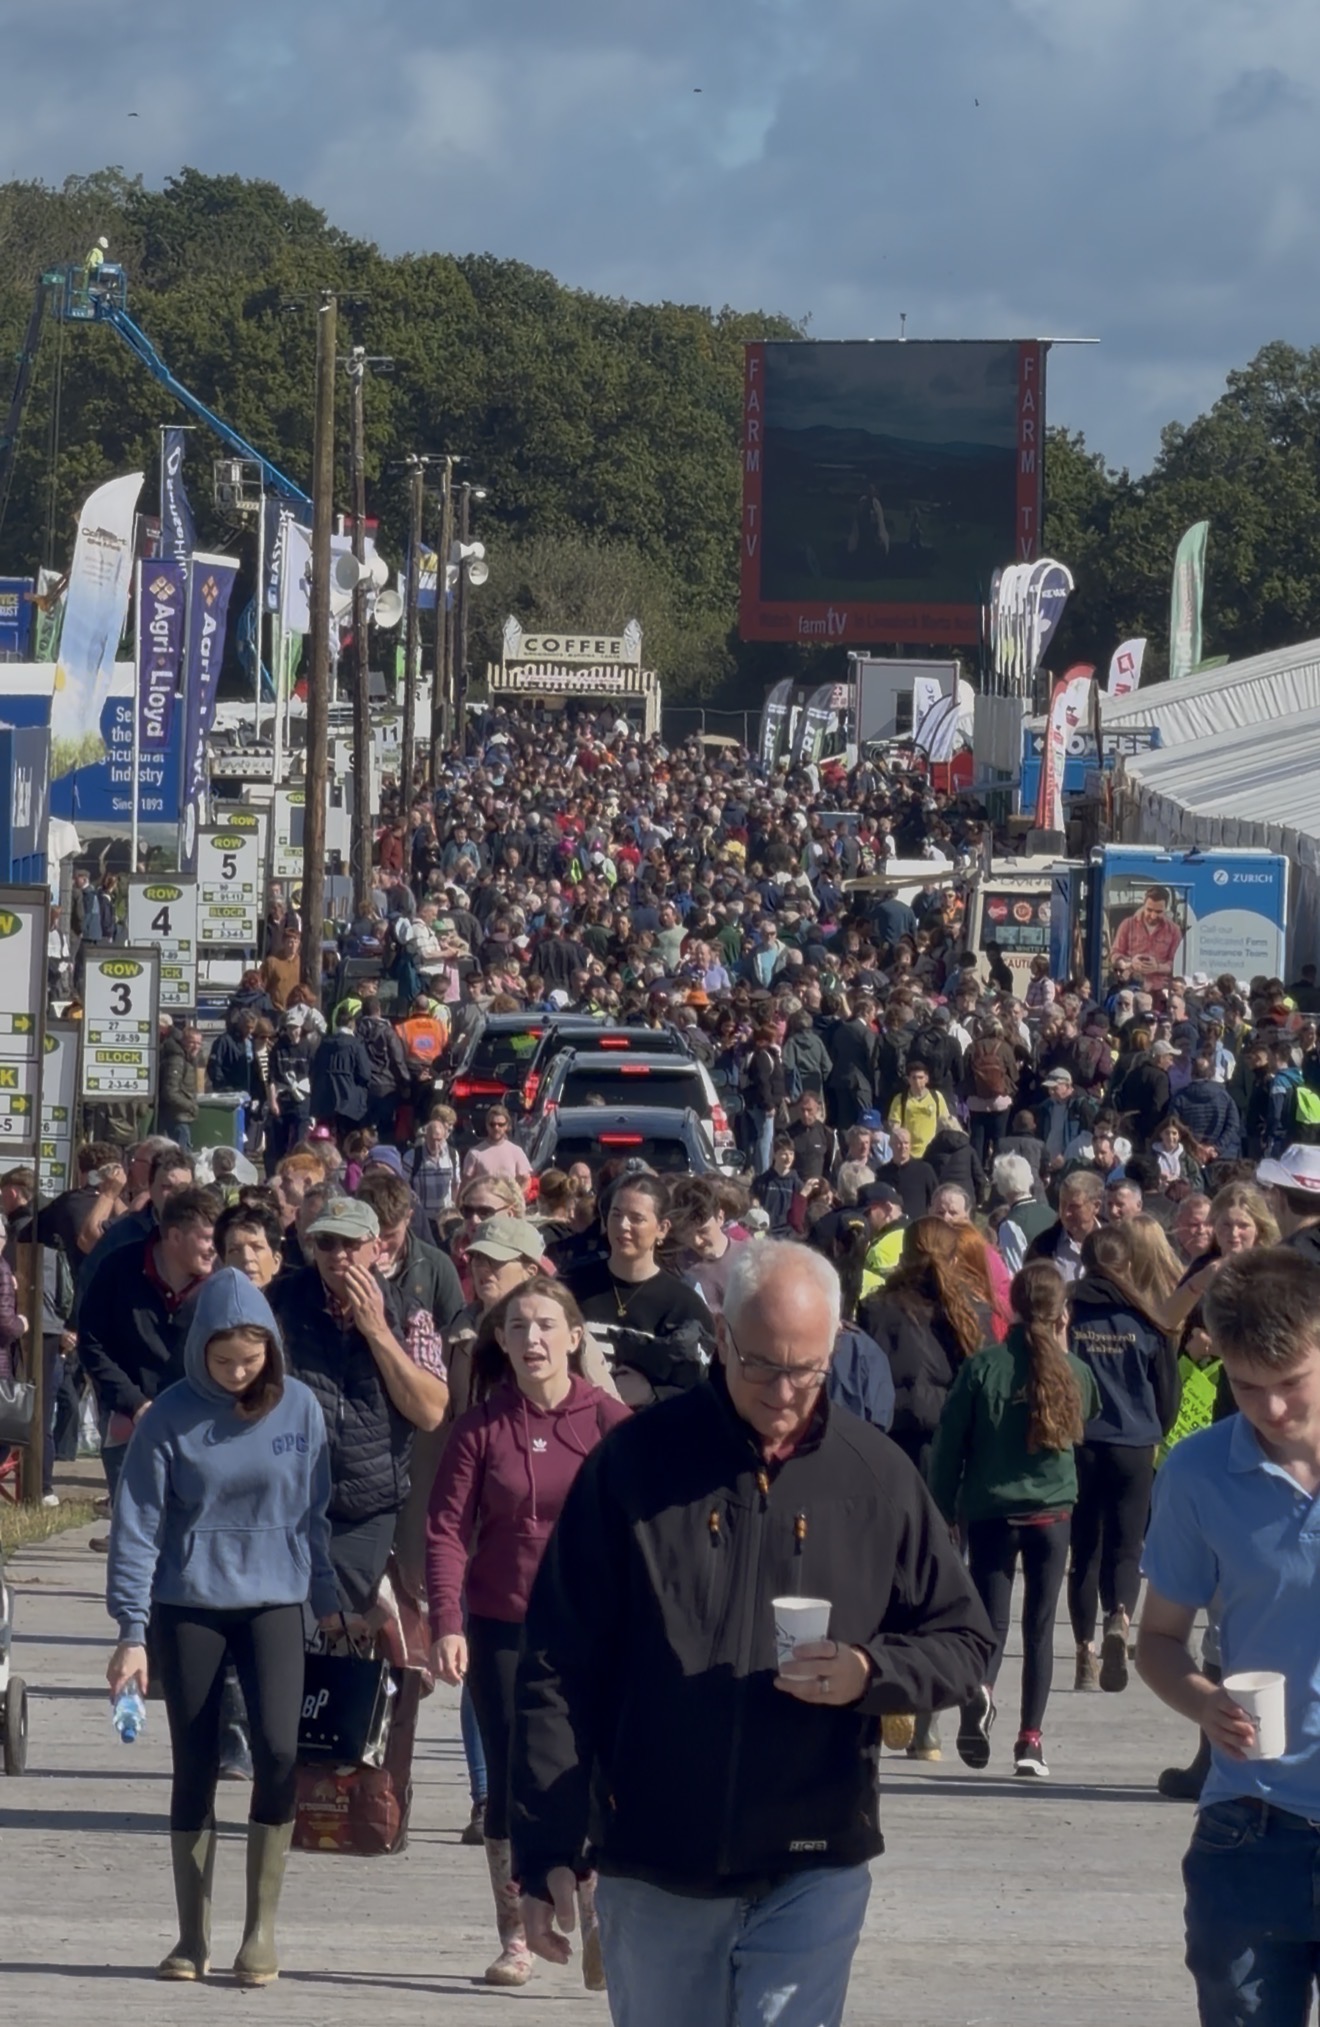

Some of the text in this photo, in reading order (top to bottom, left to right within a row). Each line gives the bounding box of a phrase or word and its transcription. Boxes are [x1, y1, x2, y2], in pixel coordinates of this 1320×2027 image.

[746, 358, 760, 558] FARM TV
[1020, 357, 1035, 561] FARM TV
[200, 611, 217, 683] Agri
[524, 637, 621, 655] COFFEE
[143, 601, 175, 738] Agri Lloyd
[111, 725, 132, 743] the
[382, 726, 398, 742] 11
[111, 765, 165, 787] Indstry
[112, 796, 164, 811] Sinc 1893
[230, 815, 256, 826] ROW
[213, 838, 243, 848] ROW
[220, 853, 238, 880] 5
[1232, 873, 1274, 884] ZURICH
[146, 888, 180, 899] ROW
[209, 907, 245, 917] BLOCK
[151, 905, 172, 937] 4
[1200, 948, 1268, 958] Insurance Team
[103, 963, 139, 976] ROW
[109, 982, 133, 1017] 3
[108, 1021, 119, 1031] 27
[115, 1033, 140, 1043] 28-59
[97, 1051, 141, 1063] BLOCK
[110, 1069, 115, 1078] 1
[107, 1080, 139, 1090] 2-3-4-5
